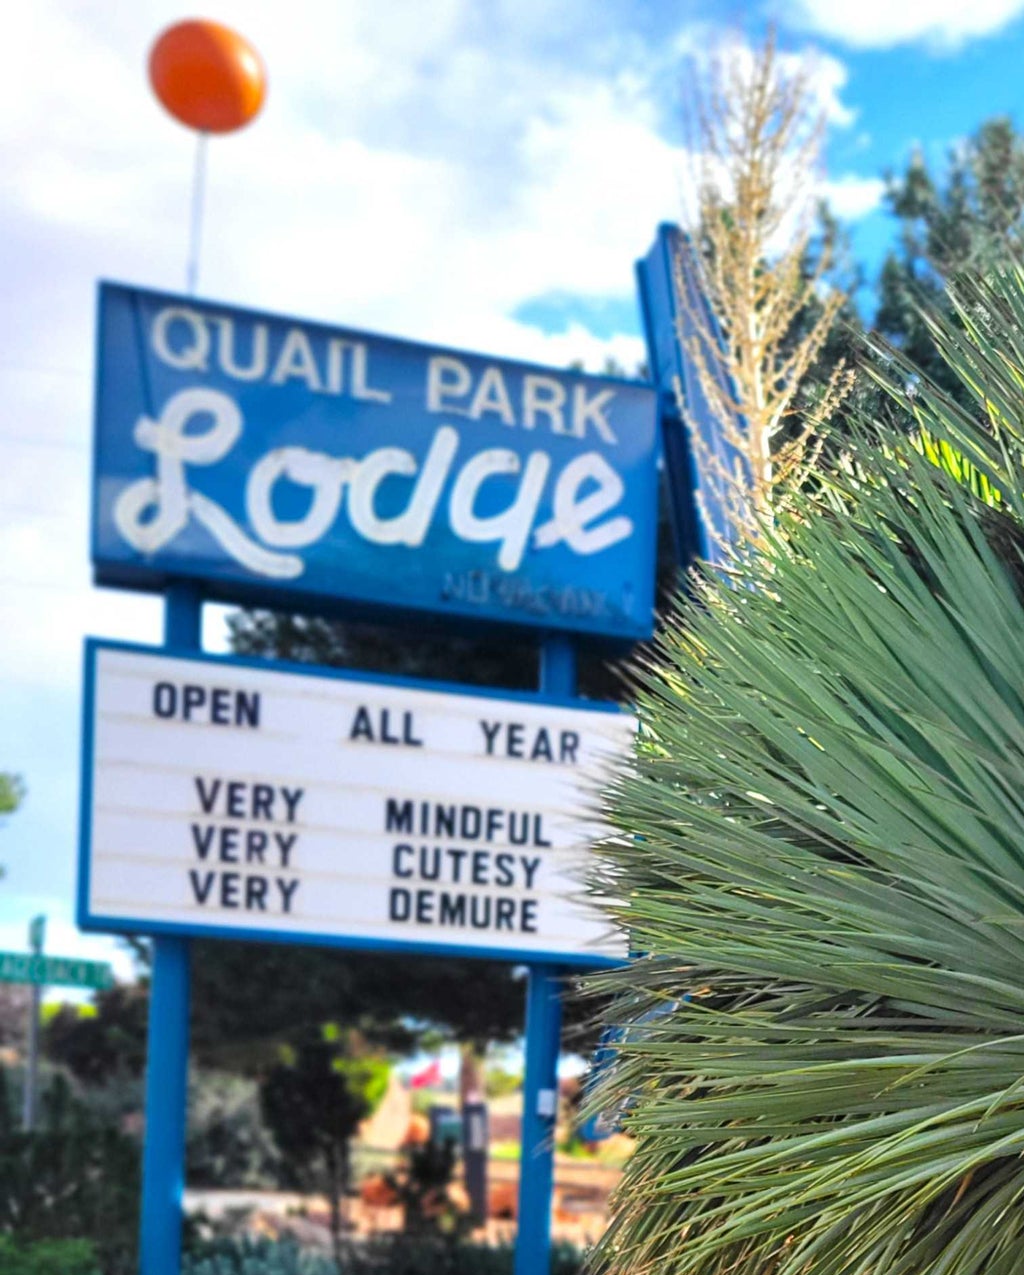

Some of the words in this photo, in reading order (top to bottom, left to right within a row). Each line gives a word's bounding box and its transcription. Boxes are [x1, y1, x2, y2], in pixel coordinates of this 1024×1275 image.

[152, 306, 392, 404] QUAIL
[427, 356, 619, 445] PARK
[152, 681, 261, 728] OPEN
[349, 705, 423, 747] ALL
[478, 720, 581, 764] YEAR
[194, 777, 305, 823] VERY
[385, 798, 552, 848] MINDFUL
[190, 824, 299, 867] VERY
[392, 844, 543, 889] CUTESY
[188, 870, 299, 913] VERY
[389, 887, 539, 933] DEMURE
